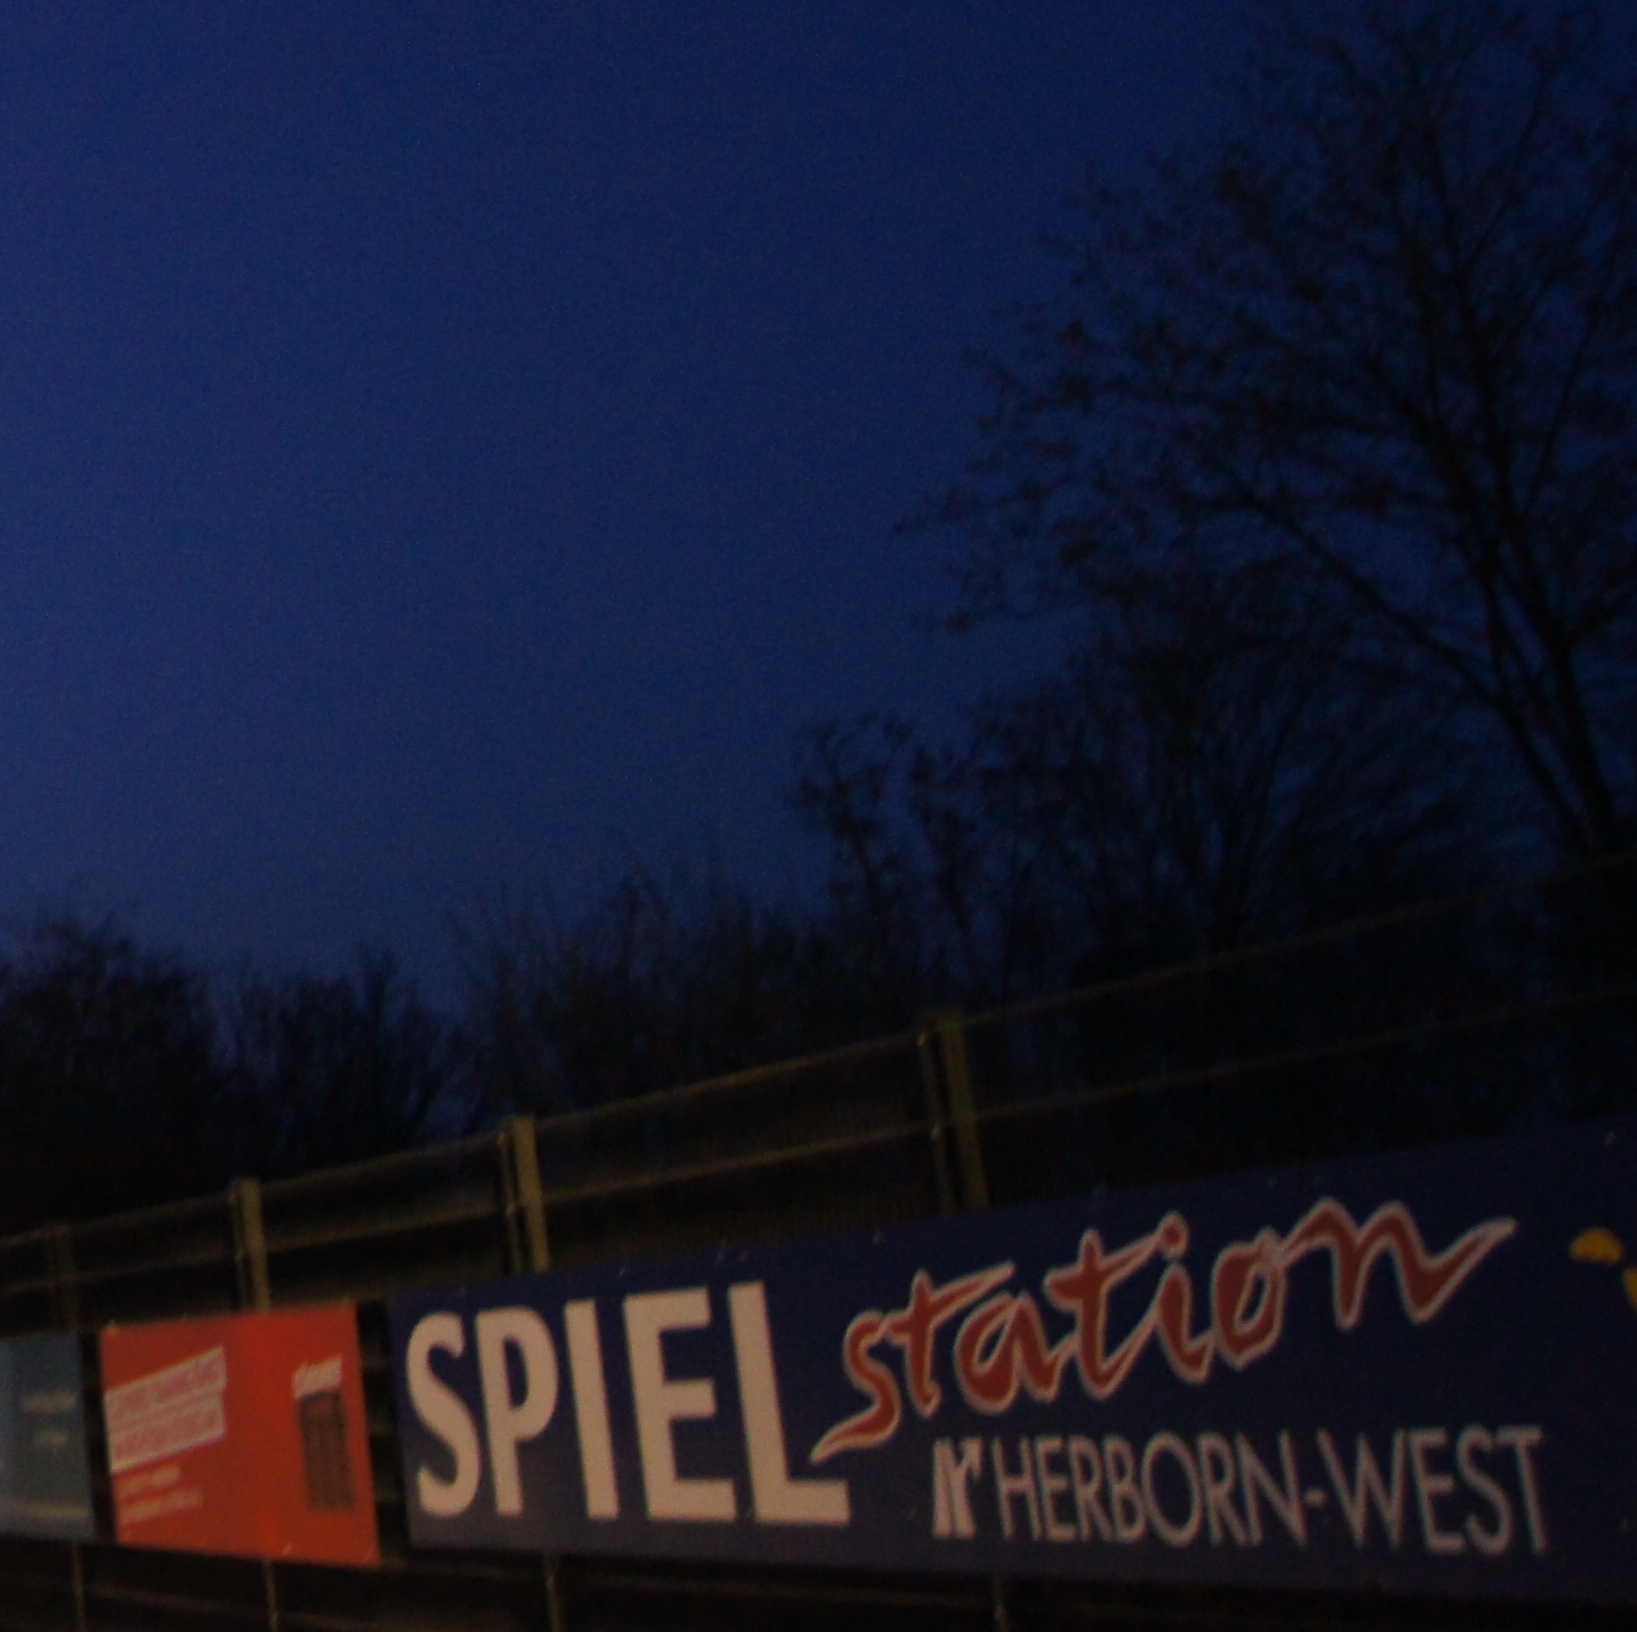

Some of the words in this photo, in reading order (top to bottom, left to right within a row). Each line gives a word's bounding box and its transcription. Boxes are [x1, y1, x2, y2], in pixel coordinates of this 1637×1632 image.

[406, 1279, 852, 1527] SPIEL
[810, 1196, 1520, 1465] station
[990, 1423, 1548, 1555] HERBORN-WEST
